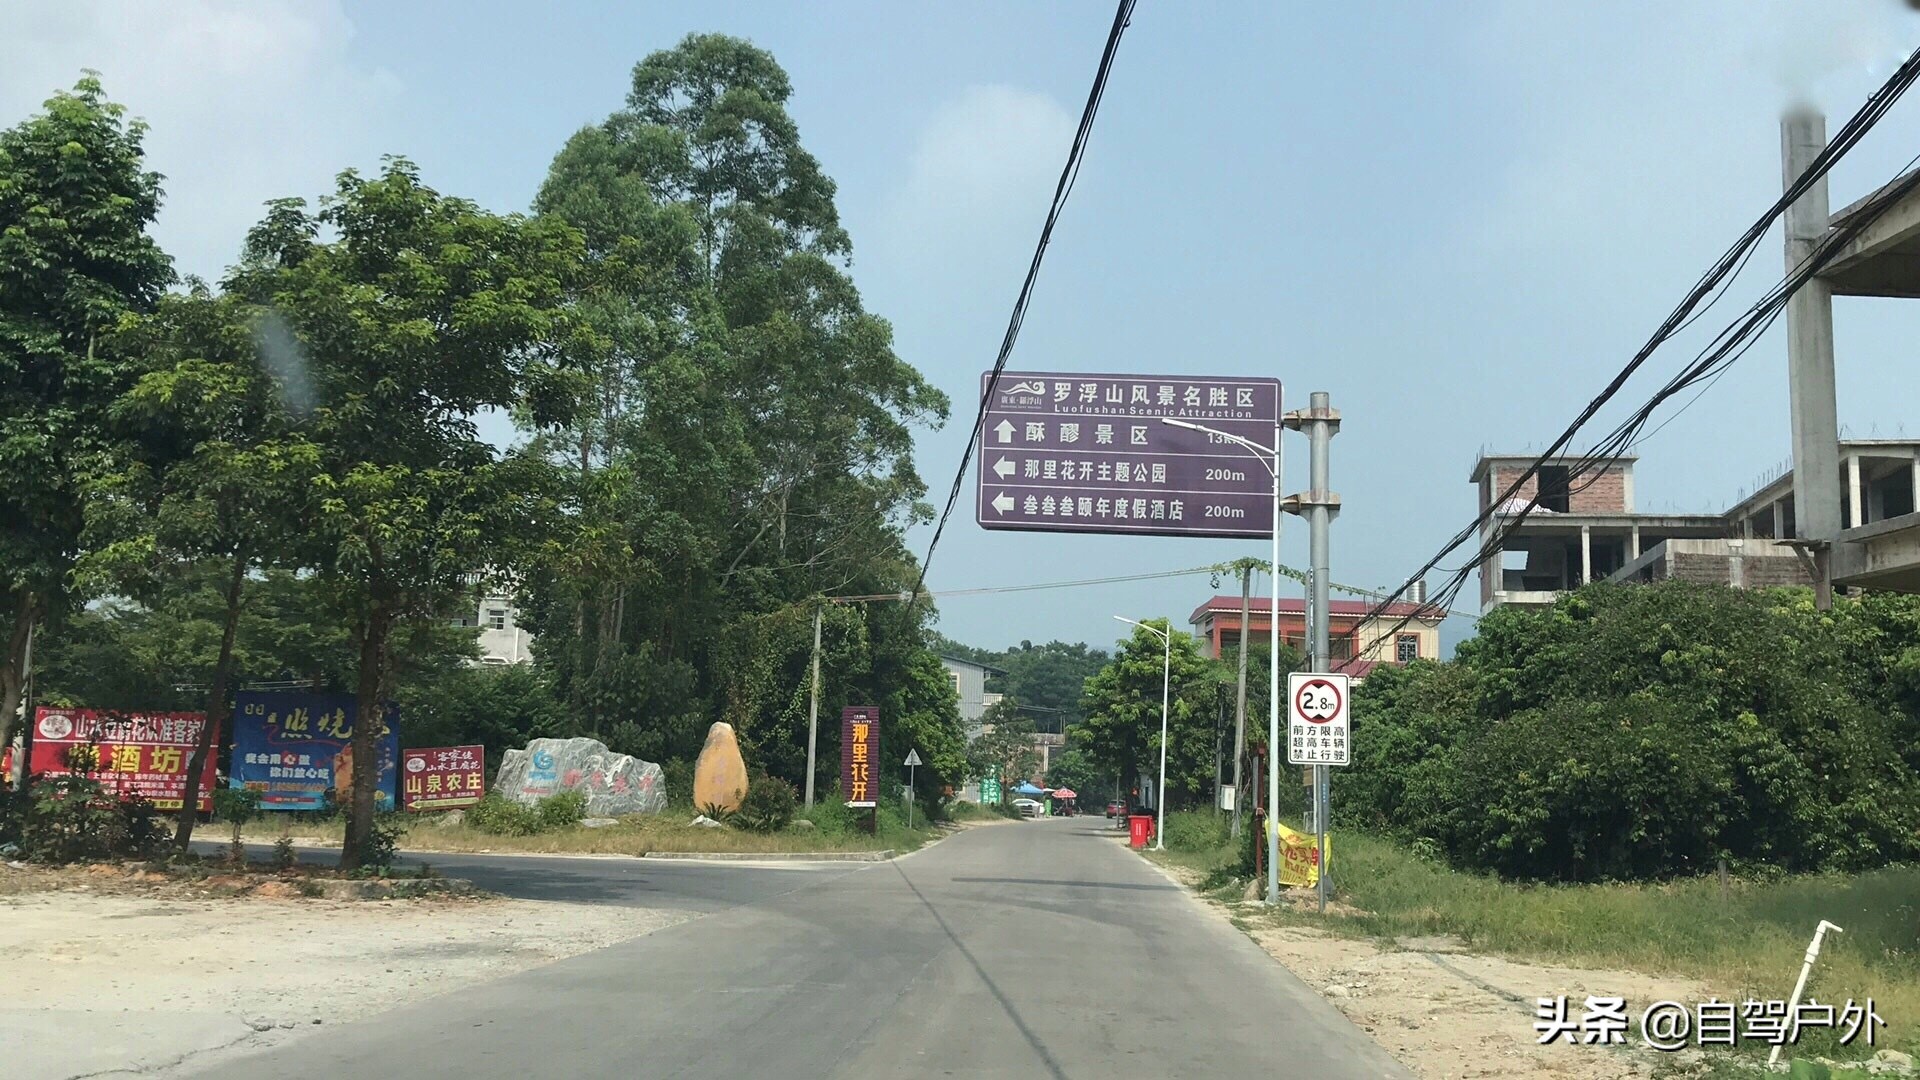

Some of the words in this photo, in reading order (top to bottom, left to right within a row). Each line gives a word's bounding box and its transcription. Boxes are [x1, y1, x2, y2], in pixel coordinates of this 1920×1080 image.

[1053, 382, 1254, 407] 罗浮山风景名胜区
[1054, 404, 1126, 415] Luofushan
[1129, 406, 1175, 416] Scenic
[1178, 407, 1253, 418] Attraction
[1026, 422, 1148, 445] 酥醪景区
[1024, 459, 1167, 483] 那里花开主题公园
[1206, 468, 1245, 481] 200m
[1023, 494, 1184, 521] 叁叁叁颐年度假酒店
[1205, 505, 1245, 518] 200m
[1302, 692, 1335, 710] 2.8m
[1293, 725, 1345, 736] 前方限高
[1293, 737, 1345, 749] 超高车辆
[851, 723, 869, 801] 那里花开
[1293, 749, 1345, 761] 禁止行驶
[407, 772, 481, 794] 山泉农庄
